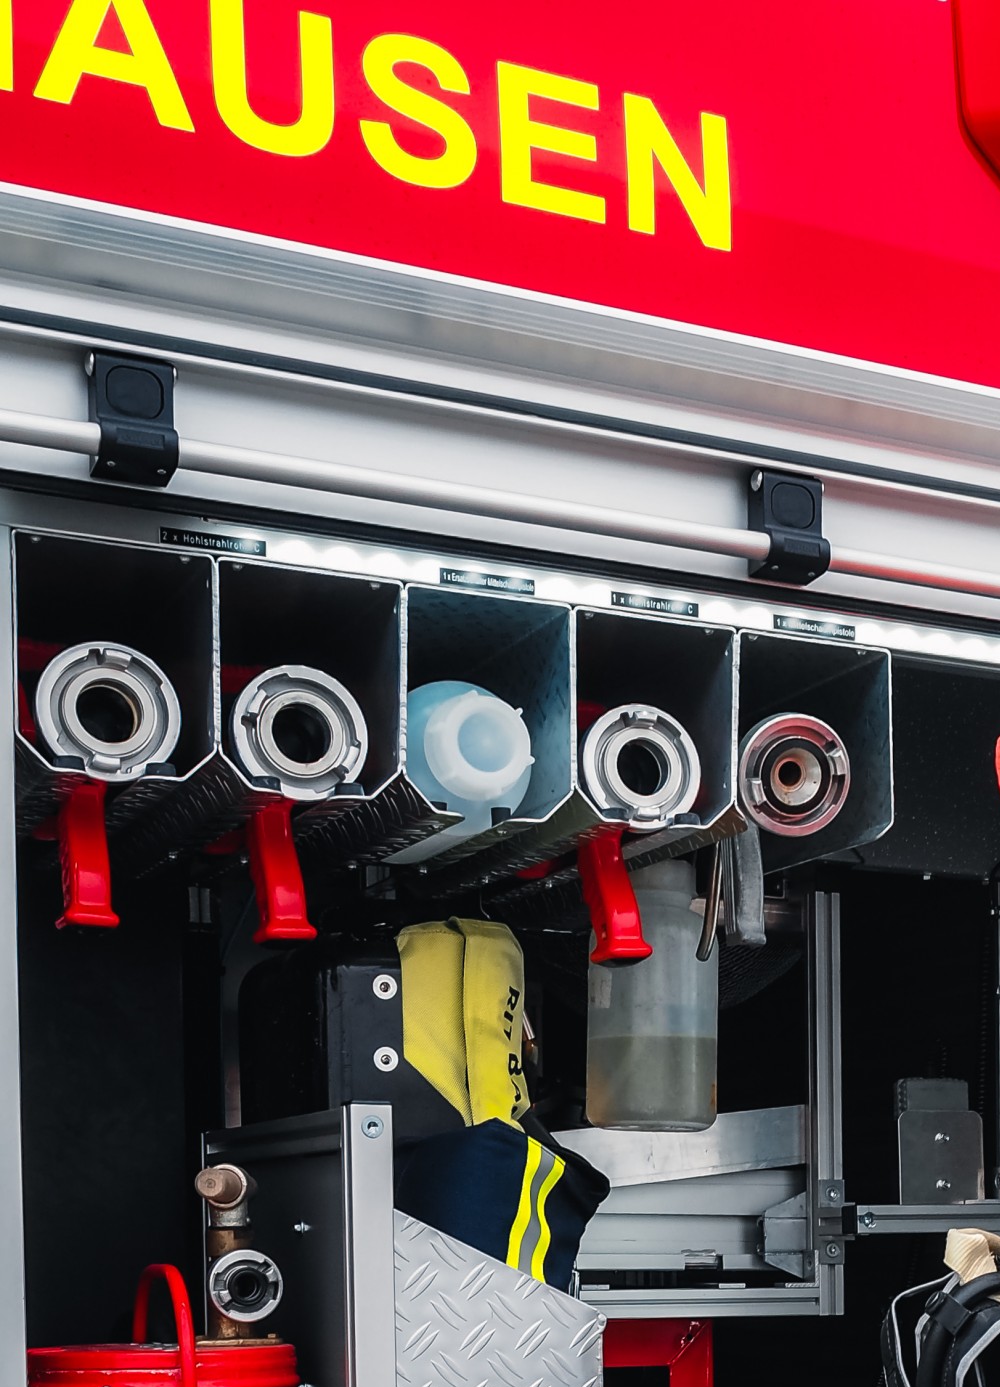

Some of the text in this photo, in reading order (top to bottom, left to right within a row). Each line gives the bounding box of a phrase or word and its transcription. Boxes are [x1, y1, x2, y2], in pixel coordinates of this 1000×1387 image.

[0, 0, 731, 252] AUSEN
[183, 533, 251, 552] Hohlstrahlroh
[254, 543, 260, 553] C
[628, 596, 684, 613] Hlstrahlr
[688, 605, 693, 614] C
[788, 619, 855, 638] ttelschapistole
[507, 1053, 523, 1119] BA
